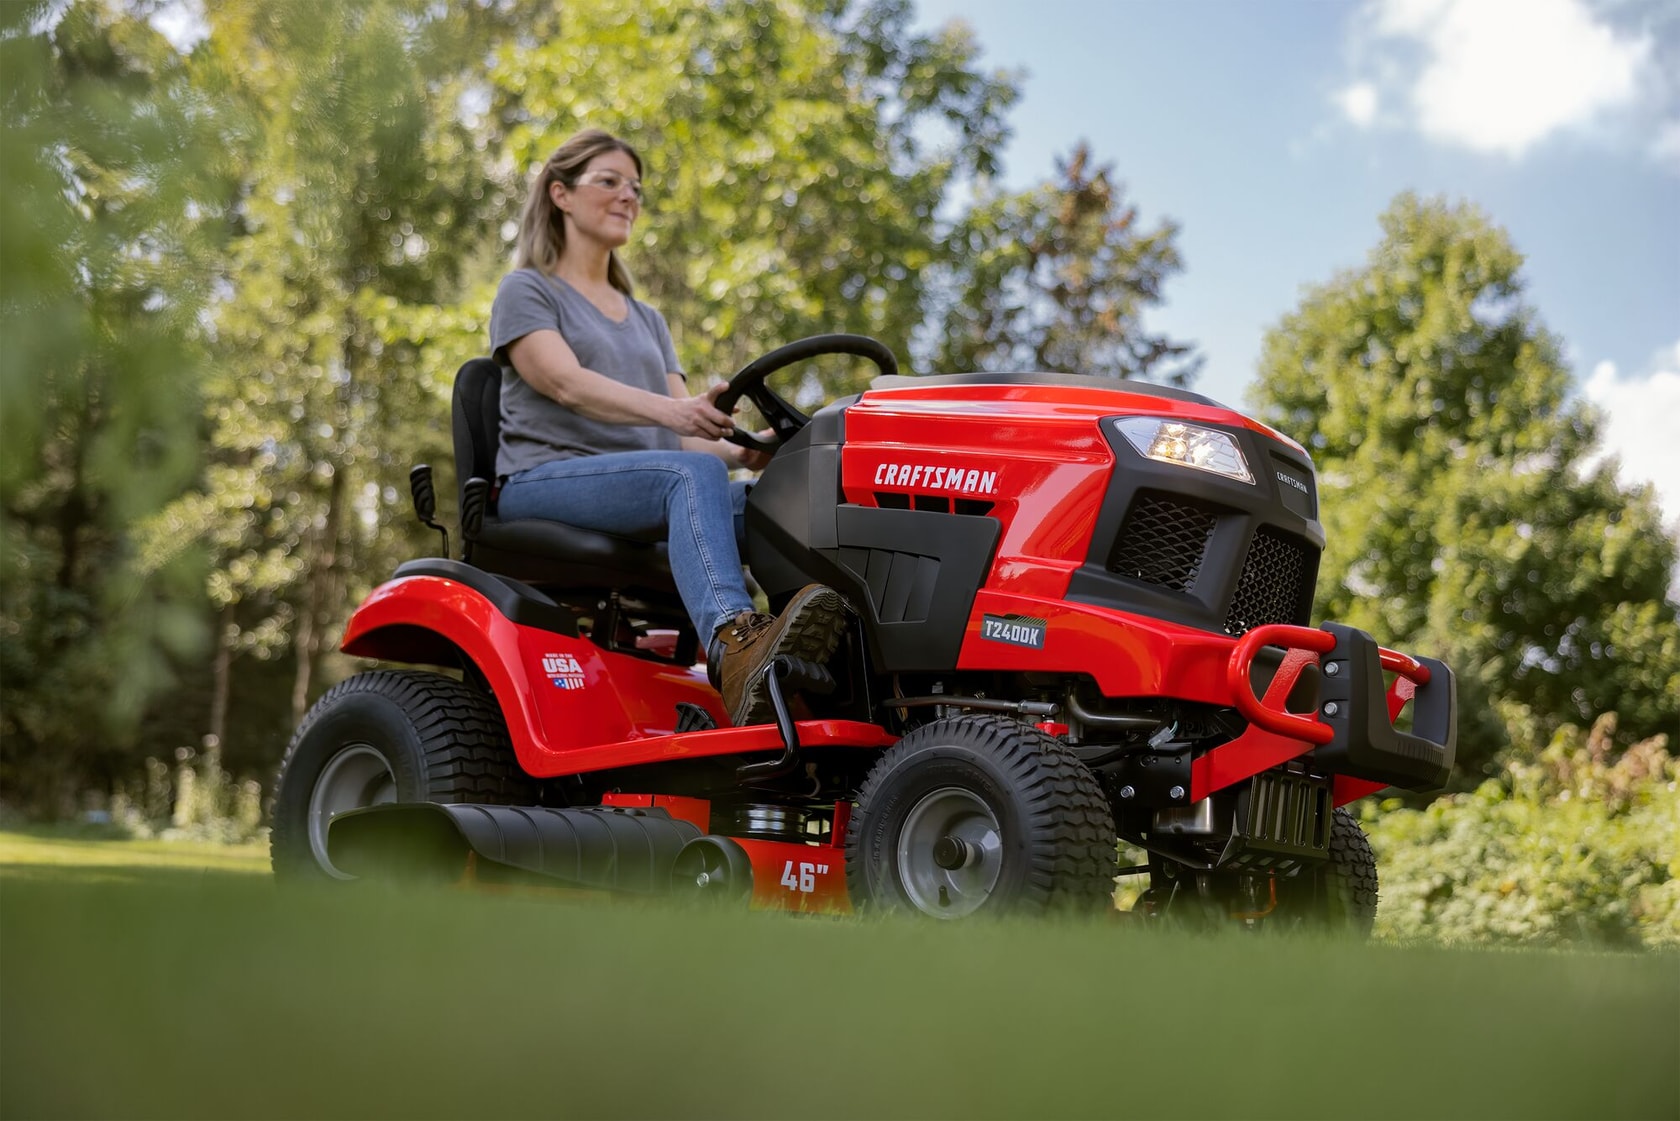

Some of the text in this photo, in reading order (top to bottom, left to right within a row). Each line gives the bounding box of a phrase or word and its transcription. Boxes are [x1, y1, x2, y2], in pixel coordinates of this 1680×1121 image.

[874, 463, 997, 493] CRAFTSMAN
[1276, 471, 1308, 493] CRAFTSMAN
[542, 658, 583, 673] USA
[780, 860, 829, 893] 46"
